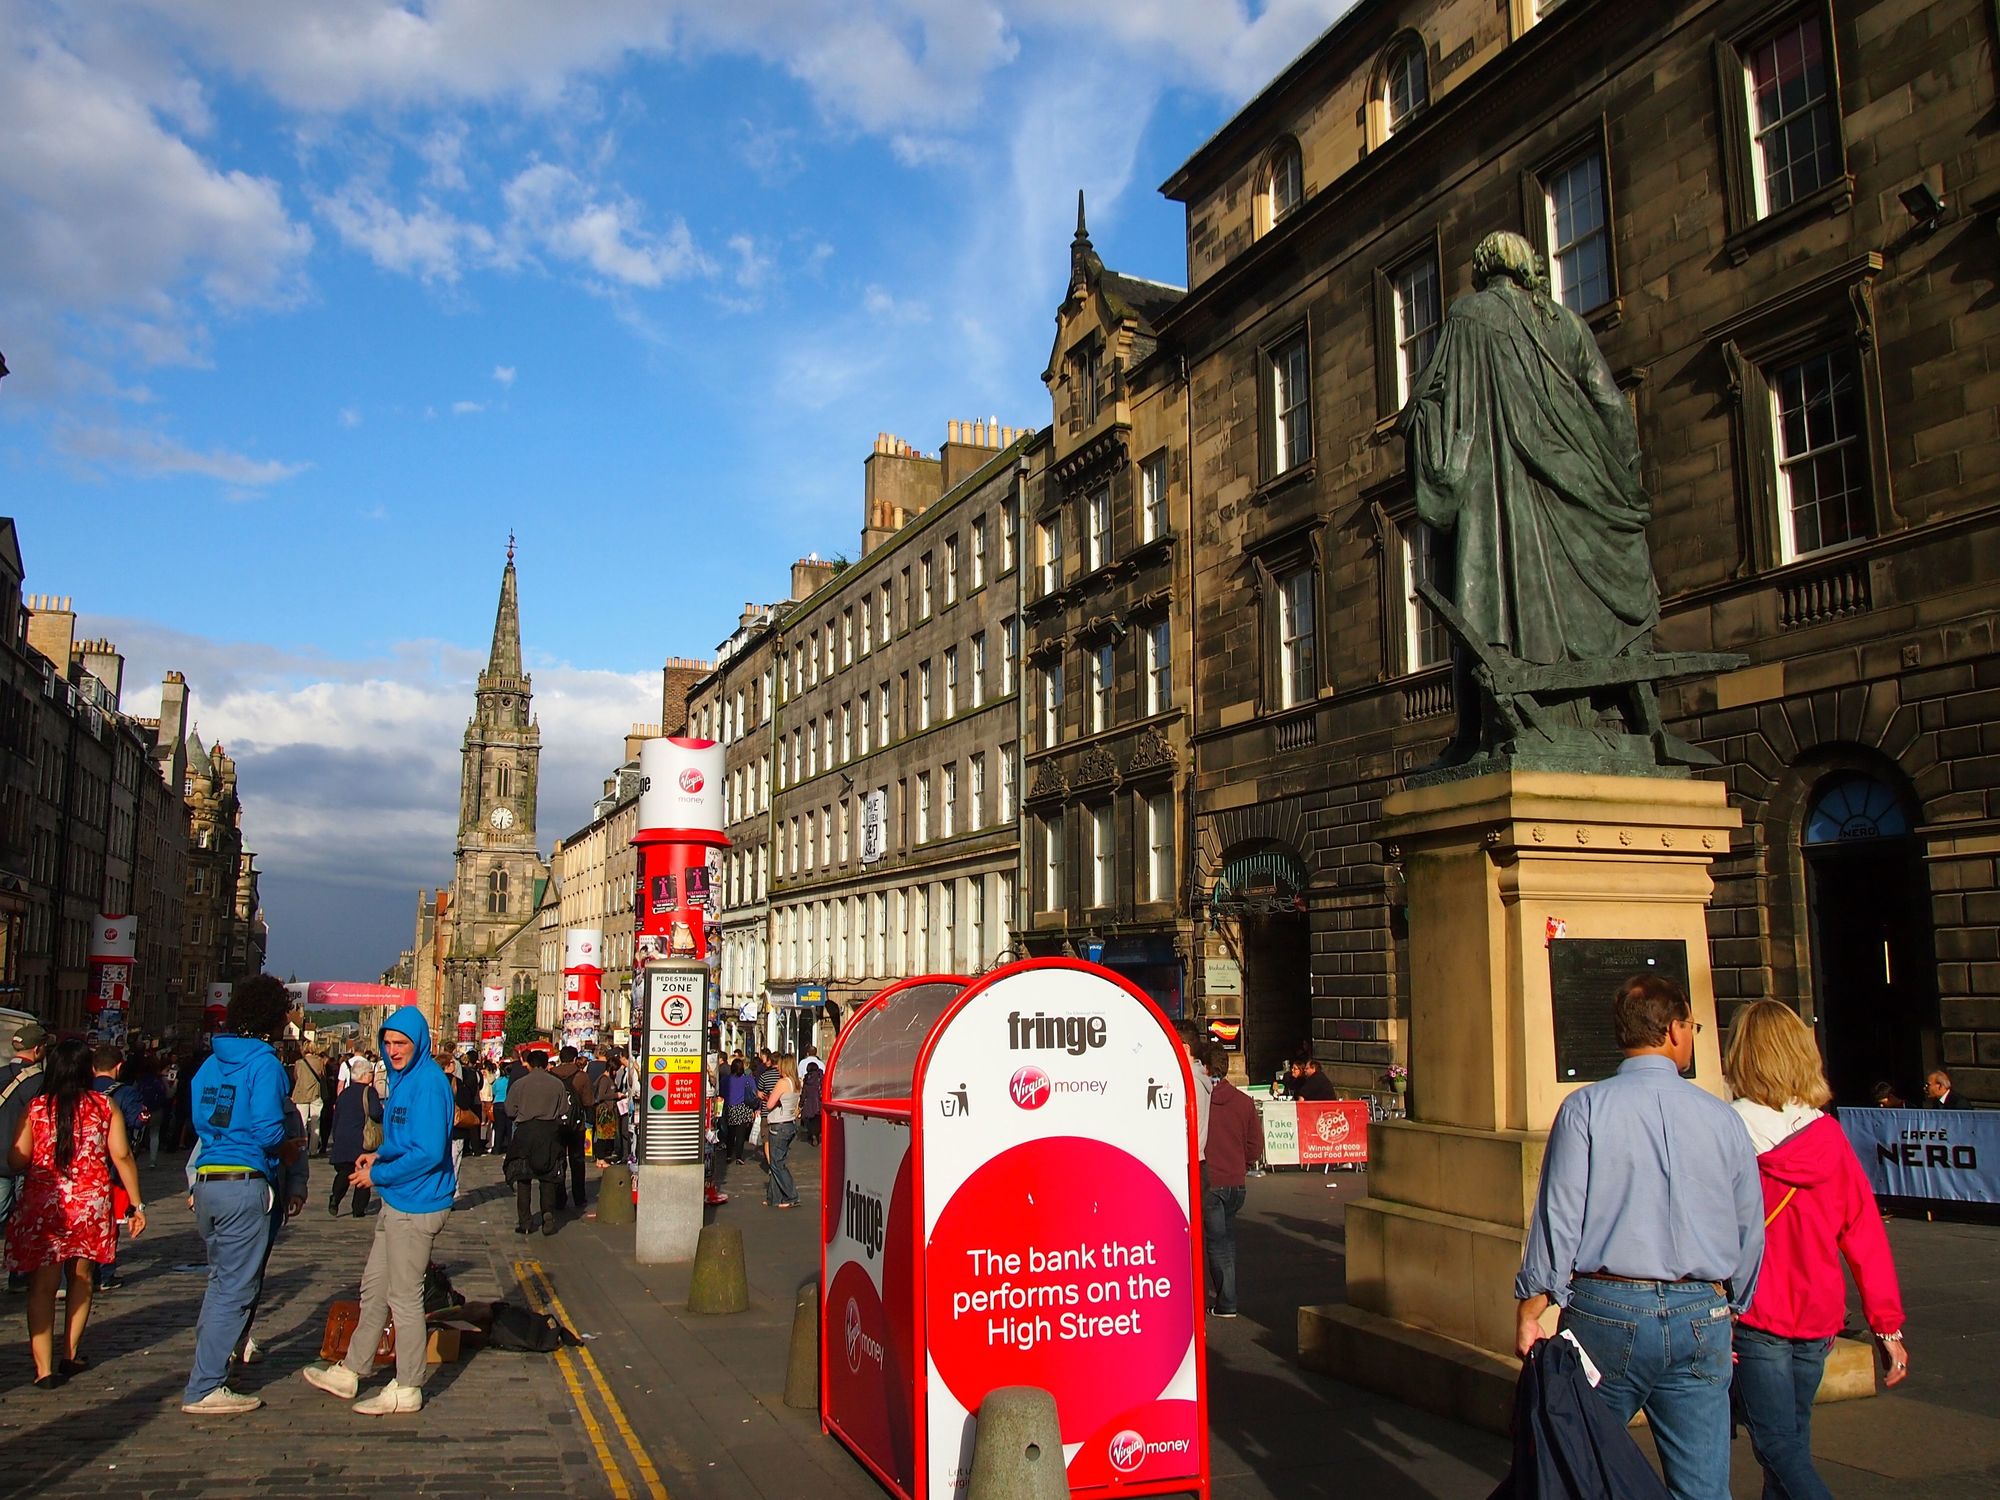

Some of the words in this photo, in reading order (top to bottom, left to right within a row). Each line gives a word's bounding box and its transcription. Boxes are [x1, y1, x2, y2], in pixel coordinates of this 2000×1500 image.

[681, 768, 704, 791] Virgin
[678, 796, 705, 805] money
[662, 983, 692, 992] ZONE
[1007, 1011, 1107, 1056] fringe
[1012, 1070, 1048, 1105] Virgin
[1054, 1079, 1108, 1096] money
[1267, 1131, 1295, 1140] Away
[1268, 1120, 1292, 1128] Take
[1901, 1129, 1948, 1141] CAFFÈ
[1268, 1141, 1296, 1150] Menu
[1343, 1150, 1367, 1158] Award
[1876, 1143, 1977, 1170] NERO
[845, 1179, 883, 1260] fringe
[966, 1249, 1021, 1277] The
[1029, 1243, 1097, 1273] bank
[1101, 1240, 1157, 1269] that
[953, 1282, 1080, 1321] performs
[1086, 1280, 1121, 1303] on
[1127, 1273, 1171, 1300] the
[988, 1315, 1052, 1351] High
[1059, 1308, 1142, 1340] Street
[861, 1332, 885, 1371] money
[1112, 1436, 1143, 1466] Virgin
[1146, 1437, 1191, 1460] money
[948, 1467, 963, 1477] Let
